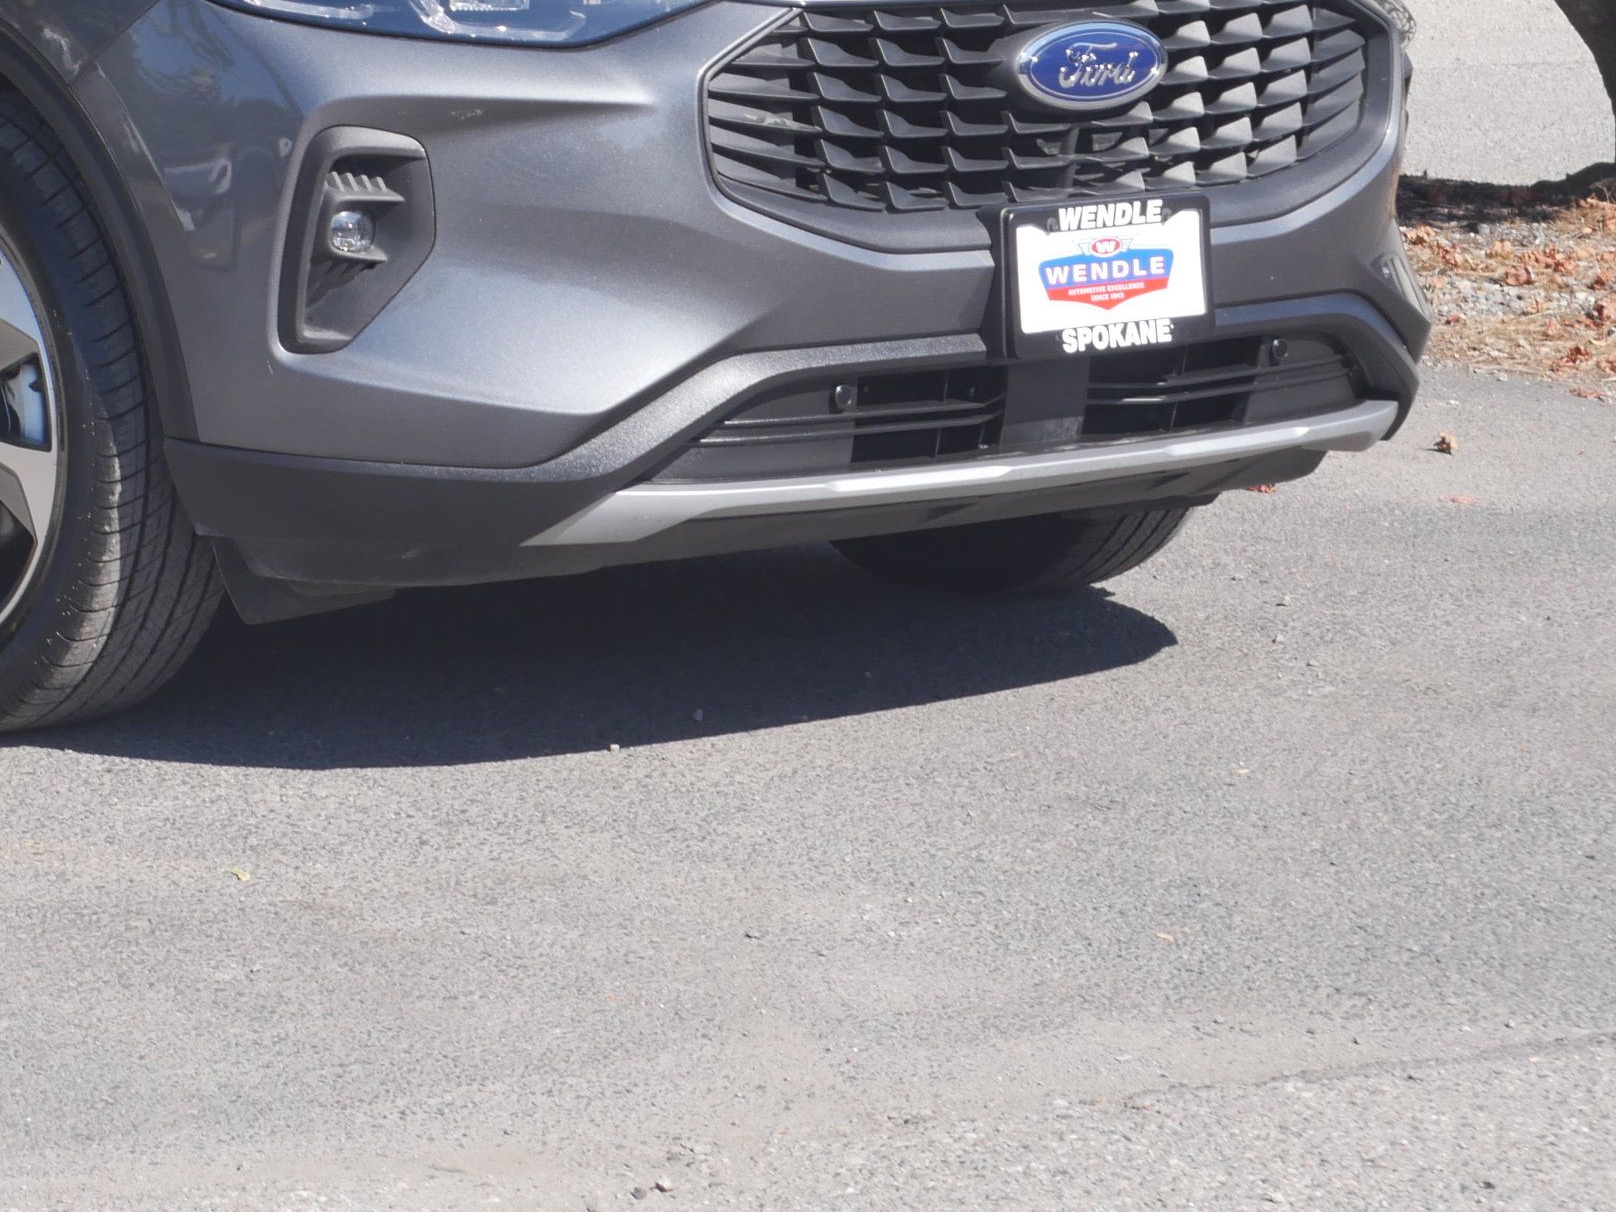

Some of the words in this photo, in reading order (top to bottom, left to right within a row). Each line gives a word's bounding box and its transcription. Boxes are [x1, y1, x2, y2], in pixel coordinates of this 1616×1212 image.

[1058, 42, 1138, 88] Ford
[1058, 199, 1163, 231] WENDLE
[1045, 256, 1165, 285] WENDLE
[1068, 285, 1106, 296] AUTOMOTIVE
[1107, 282, 1145, 293] EXCELLENCE
[1061, 318, 1172, 354] SPOKANE
